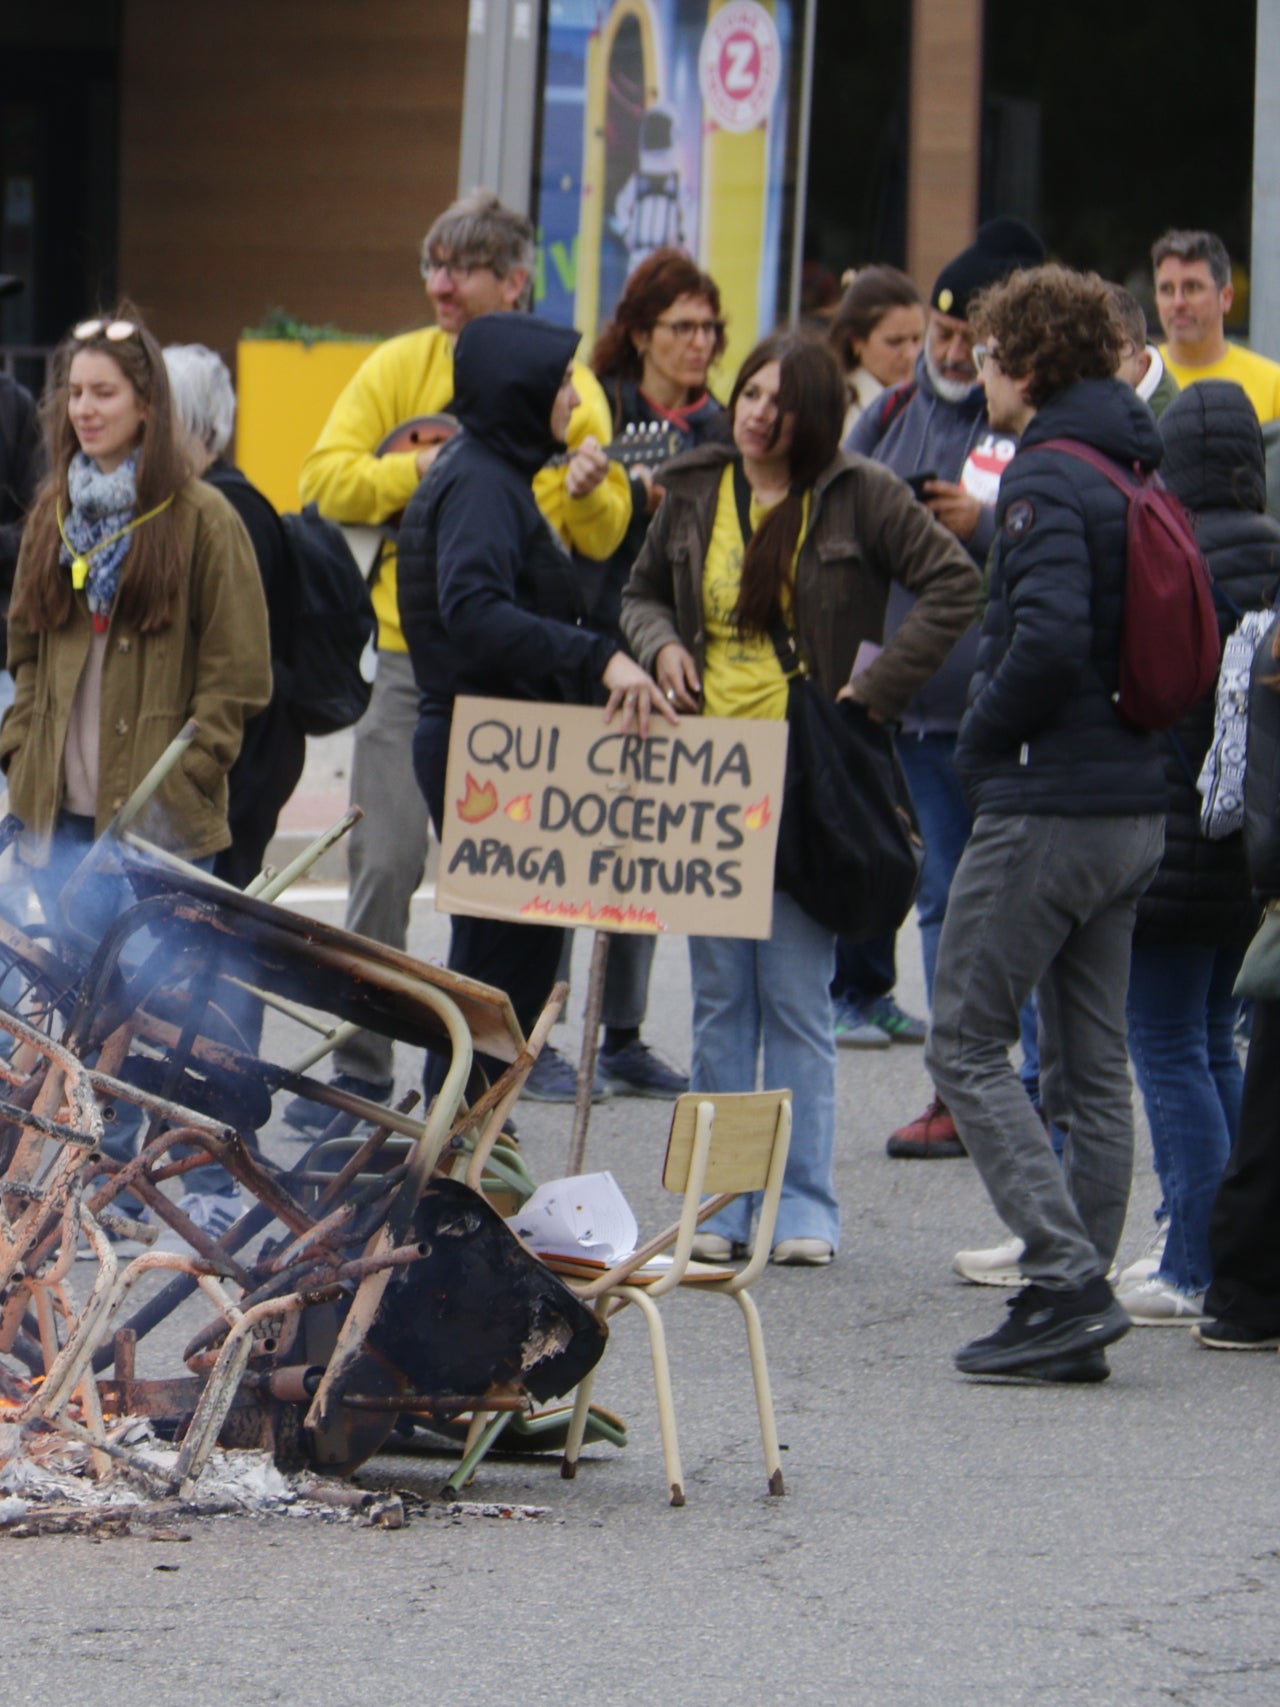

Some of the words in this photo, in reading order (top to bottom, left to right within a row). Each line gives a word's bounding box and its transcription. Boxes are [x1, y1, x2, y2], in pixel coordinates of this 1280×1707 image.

[725, 40, 755, 89] Z
[467, 719, 560, 772] QUI
[587, 732, 752, 788] CREMA
[539, 786, 745, 851] DOCENTS
[448, 836, 566, 888] APAGA
[588, 848, 743, 899] FUTURS
